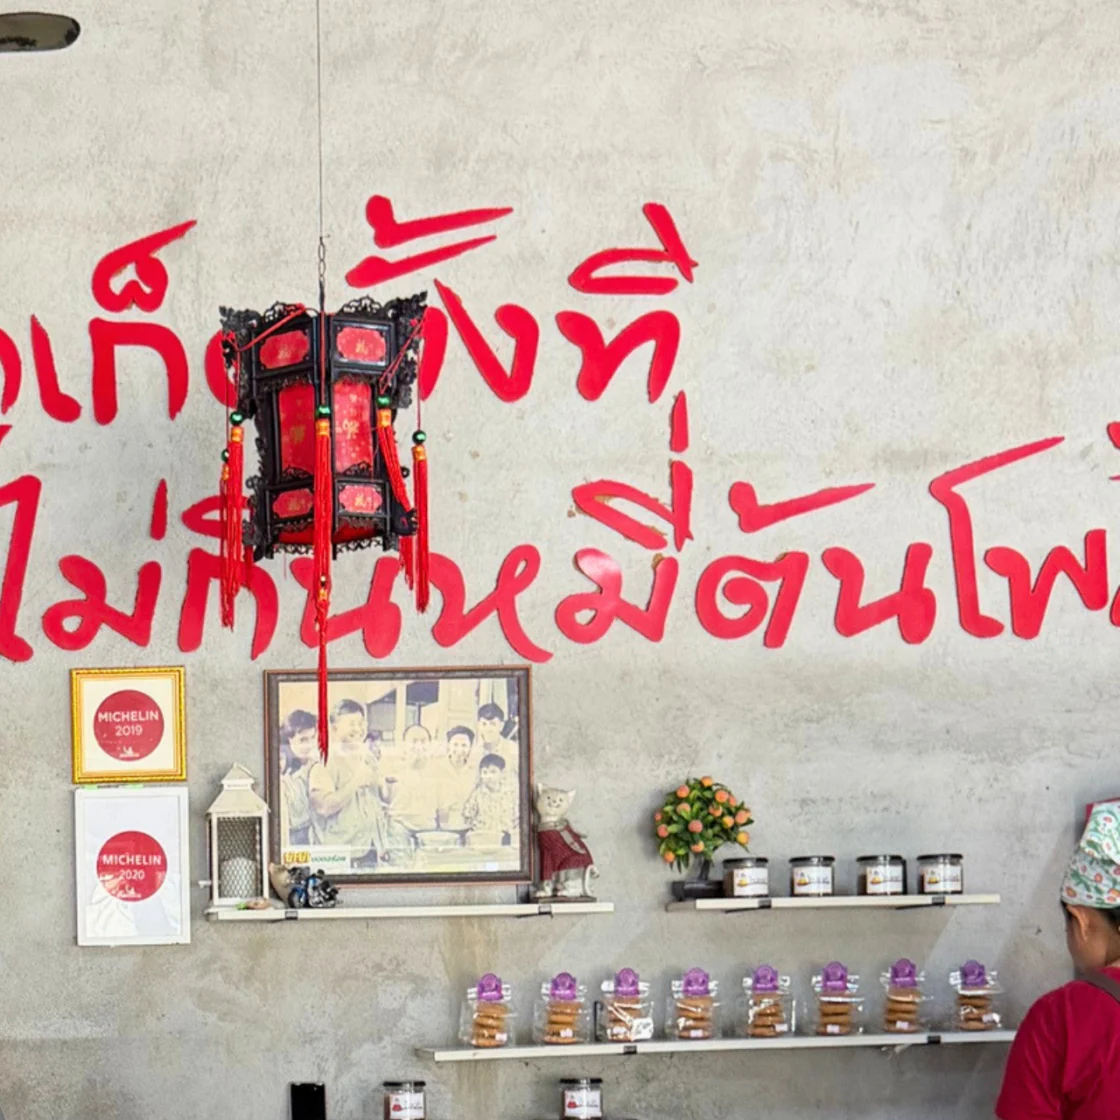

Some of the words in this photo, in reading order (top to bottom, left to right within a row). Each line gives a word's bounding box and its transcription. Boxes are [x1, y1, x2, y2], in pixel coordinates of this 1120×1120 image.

[97, 709, 159, 723] MICHELIN
[115, 724, 143, 737] 2019
[102, 853, 162, 866] MICHELIN
[120, 869, 145, 880] 2020
